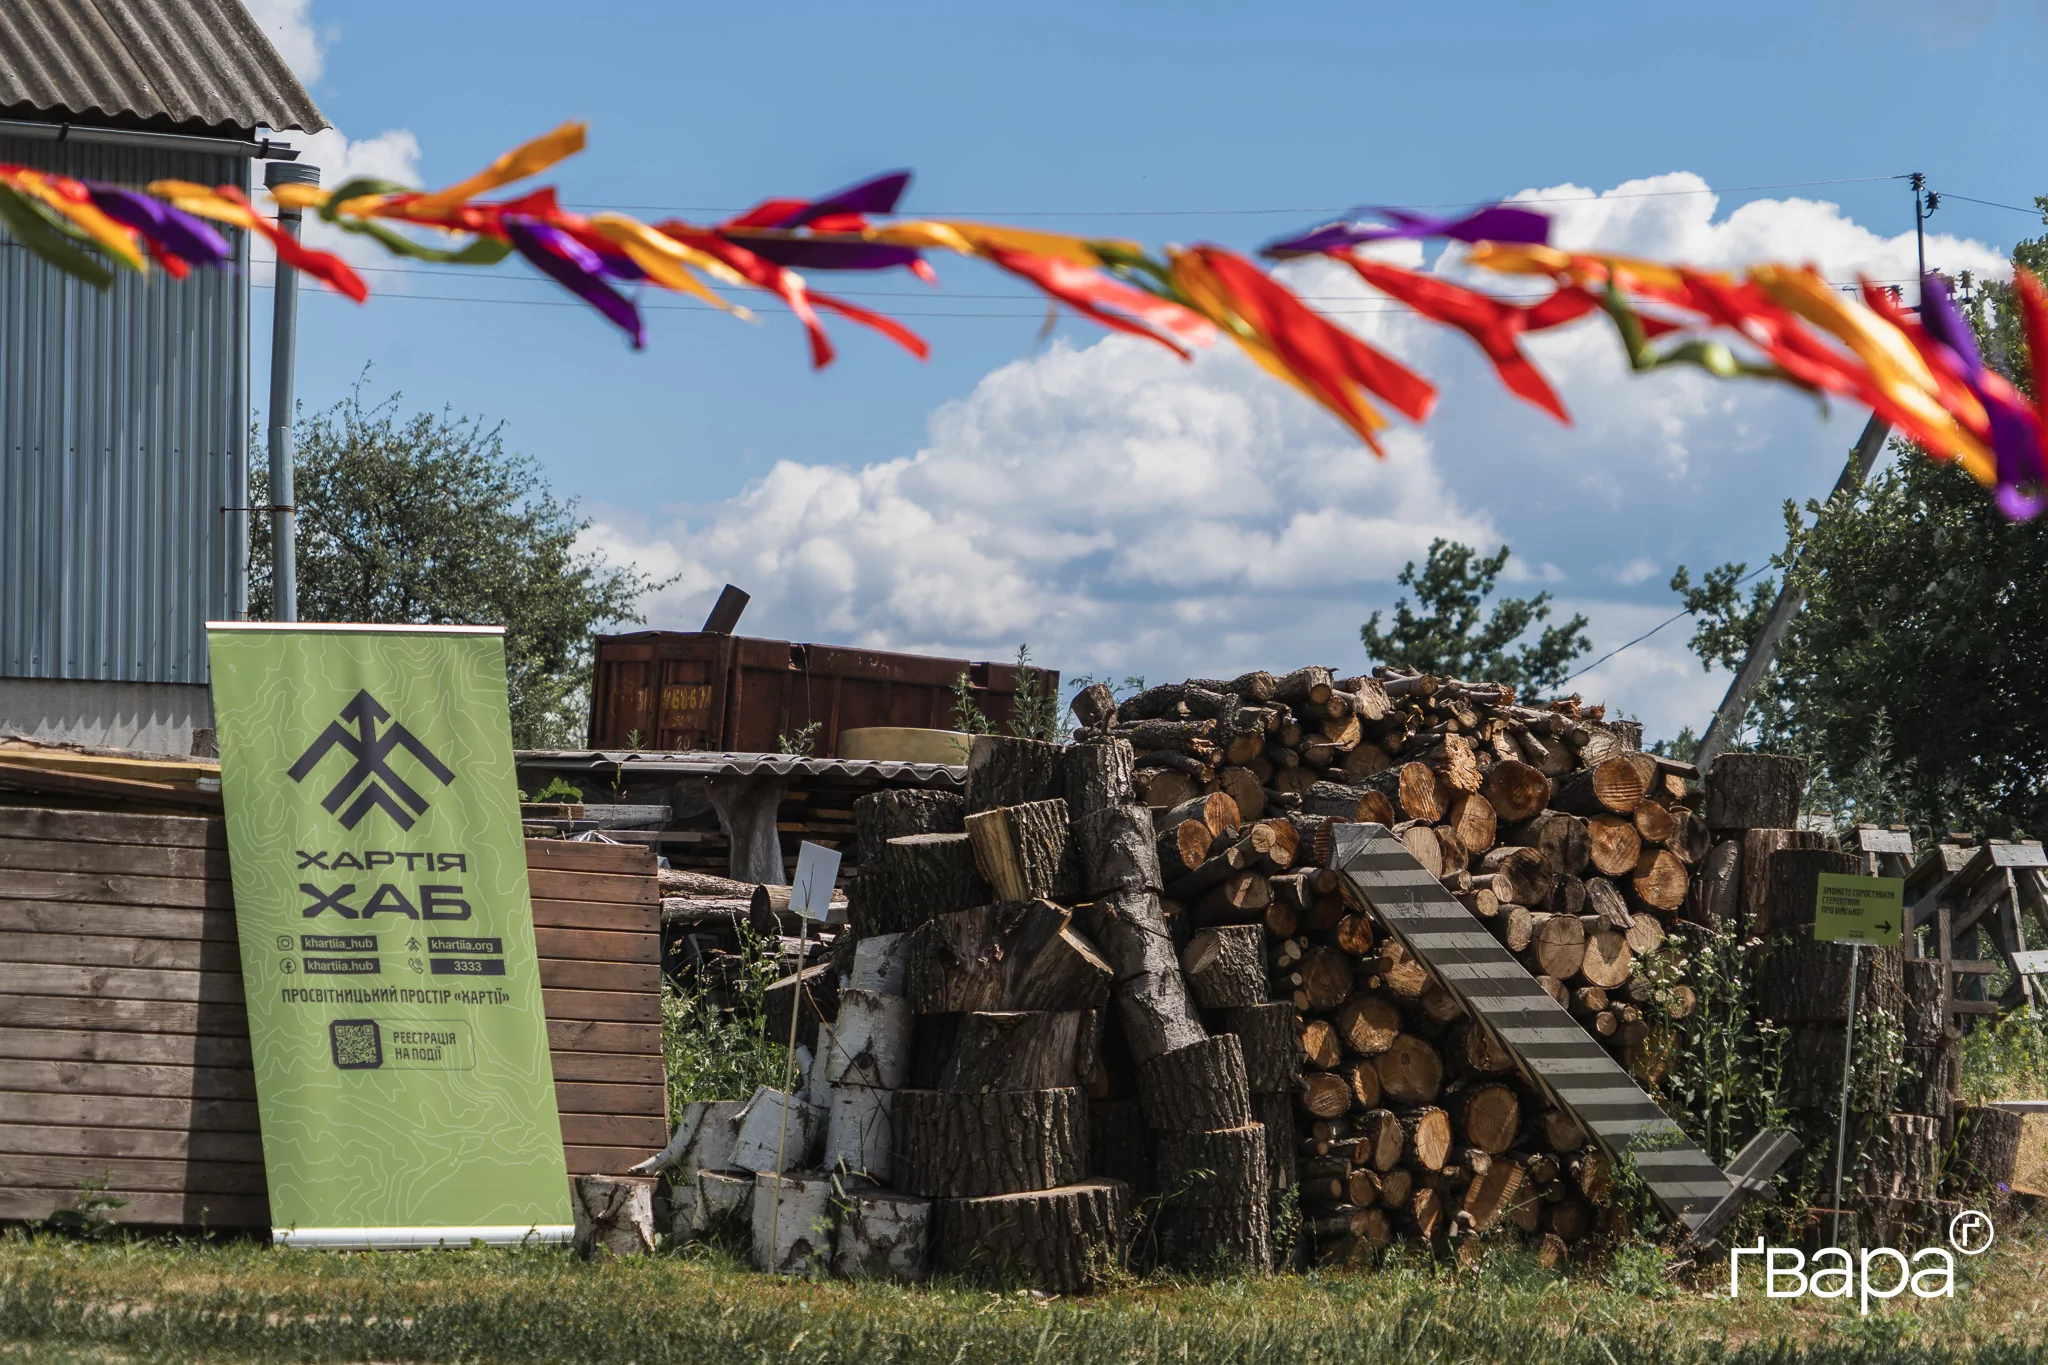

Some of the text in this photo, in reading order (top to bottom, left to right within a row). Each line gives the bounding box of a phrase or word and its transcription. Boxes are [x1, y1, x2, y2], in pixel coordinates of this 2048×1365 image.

[295, 850, 467, 873] ХАРТІЯ
[1823, 887, 1852, 897] ЗМОЖЕТЕ
[299, 883, 472, 920] ХАБ
[1821, 905, 1834, 914] ПРО
[304, 938, 373, 950] khartiia_hub
[431, 939, 493, 953] khartiia.org
[307, 960, 374, 971] khartiia.hub
[453, 961, 482, 972] 3333
[281, 986, 510, 1005] ПРОСВІТНИЦЬКИЙ ПРОСТІР «ХАРТІЇ»
[395, 1046, 441, 1062] НА ПОДІЇ
